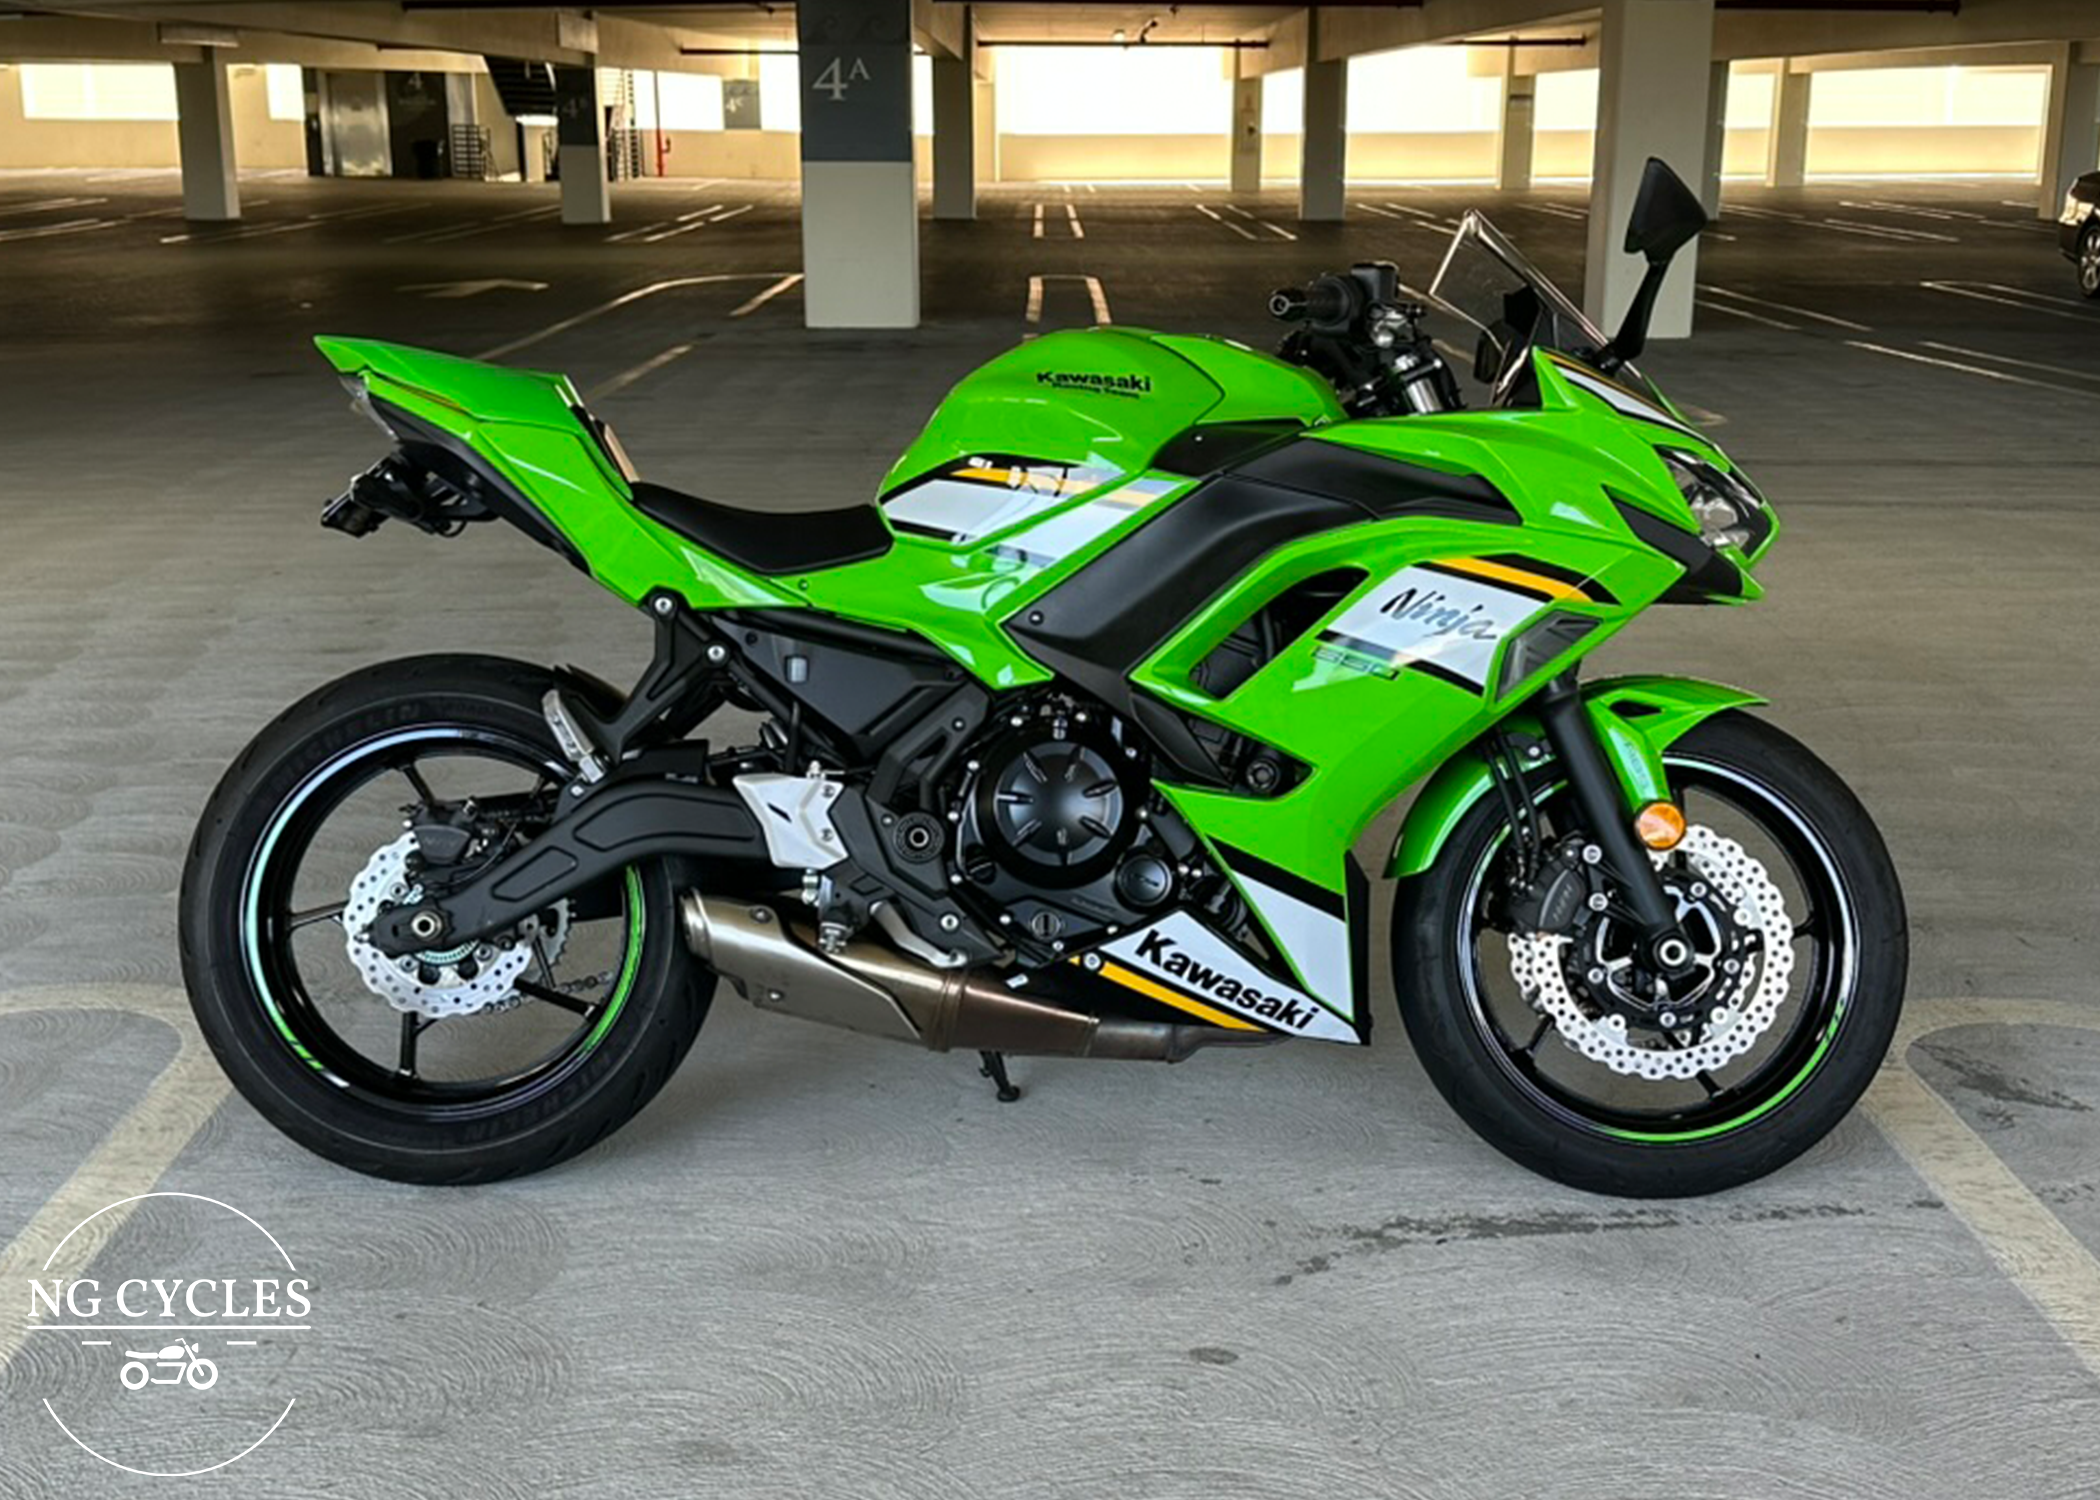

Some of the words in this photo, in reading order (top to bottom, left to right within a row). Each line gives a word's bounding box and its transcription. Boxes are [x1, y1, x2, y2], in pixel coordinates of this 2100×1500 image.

[812, 57, 871, 101] 4A
[1036, 371, 1152, 393] Kawasaki
[1379, 587, 1498, 640] Ninja
[1135, 929, 1320, 1029] Kawasaki
